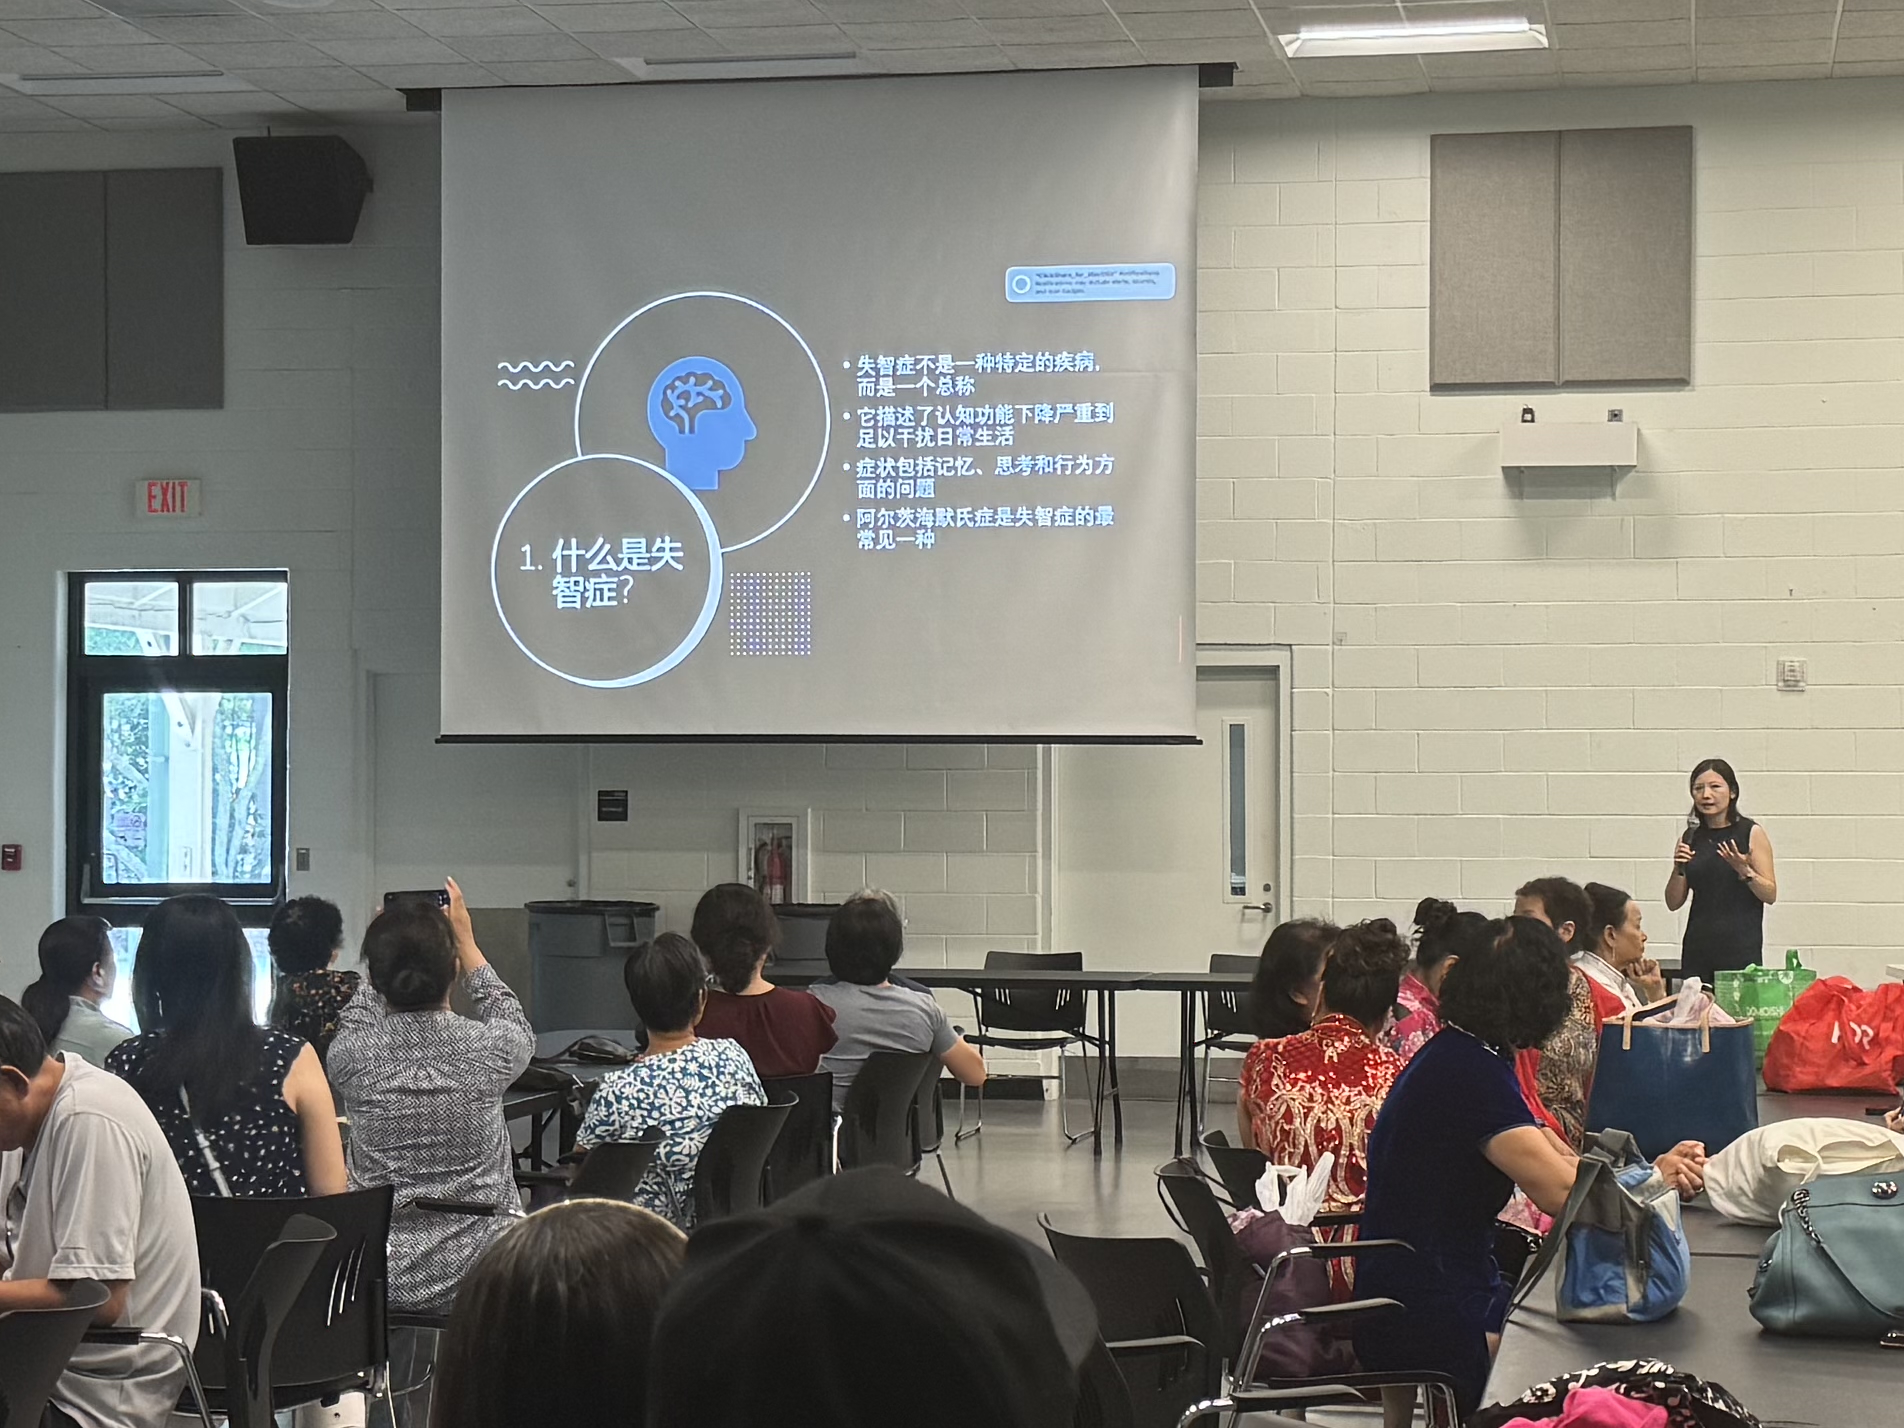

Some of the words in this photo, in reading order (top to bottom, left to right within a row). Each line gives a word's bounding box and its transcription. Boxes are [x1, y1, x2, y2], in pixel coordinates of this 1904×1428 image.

[856, 375, 976, 398] 而是一个总称
[856, 401, 1115, 427] 它描述了认知功能下降严重到
[856, 426, 1015, 449] 足以干扰日常生活
[856, 453, 1115, 479] 症状包括记忆、思考和行为方
[147, 481, 189, 513] EXIT
[856, 478, 936, 500] 面的问题
[856, 505, 1115, 530] 阿尔茨海默氏症是失智症的最
[856, 529, 935, 551] 常见一种
[519, 543, 544, 571] 1.
[552, 535, 685, 573] 什么是失
